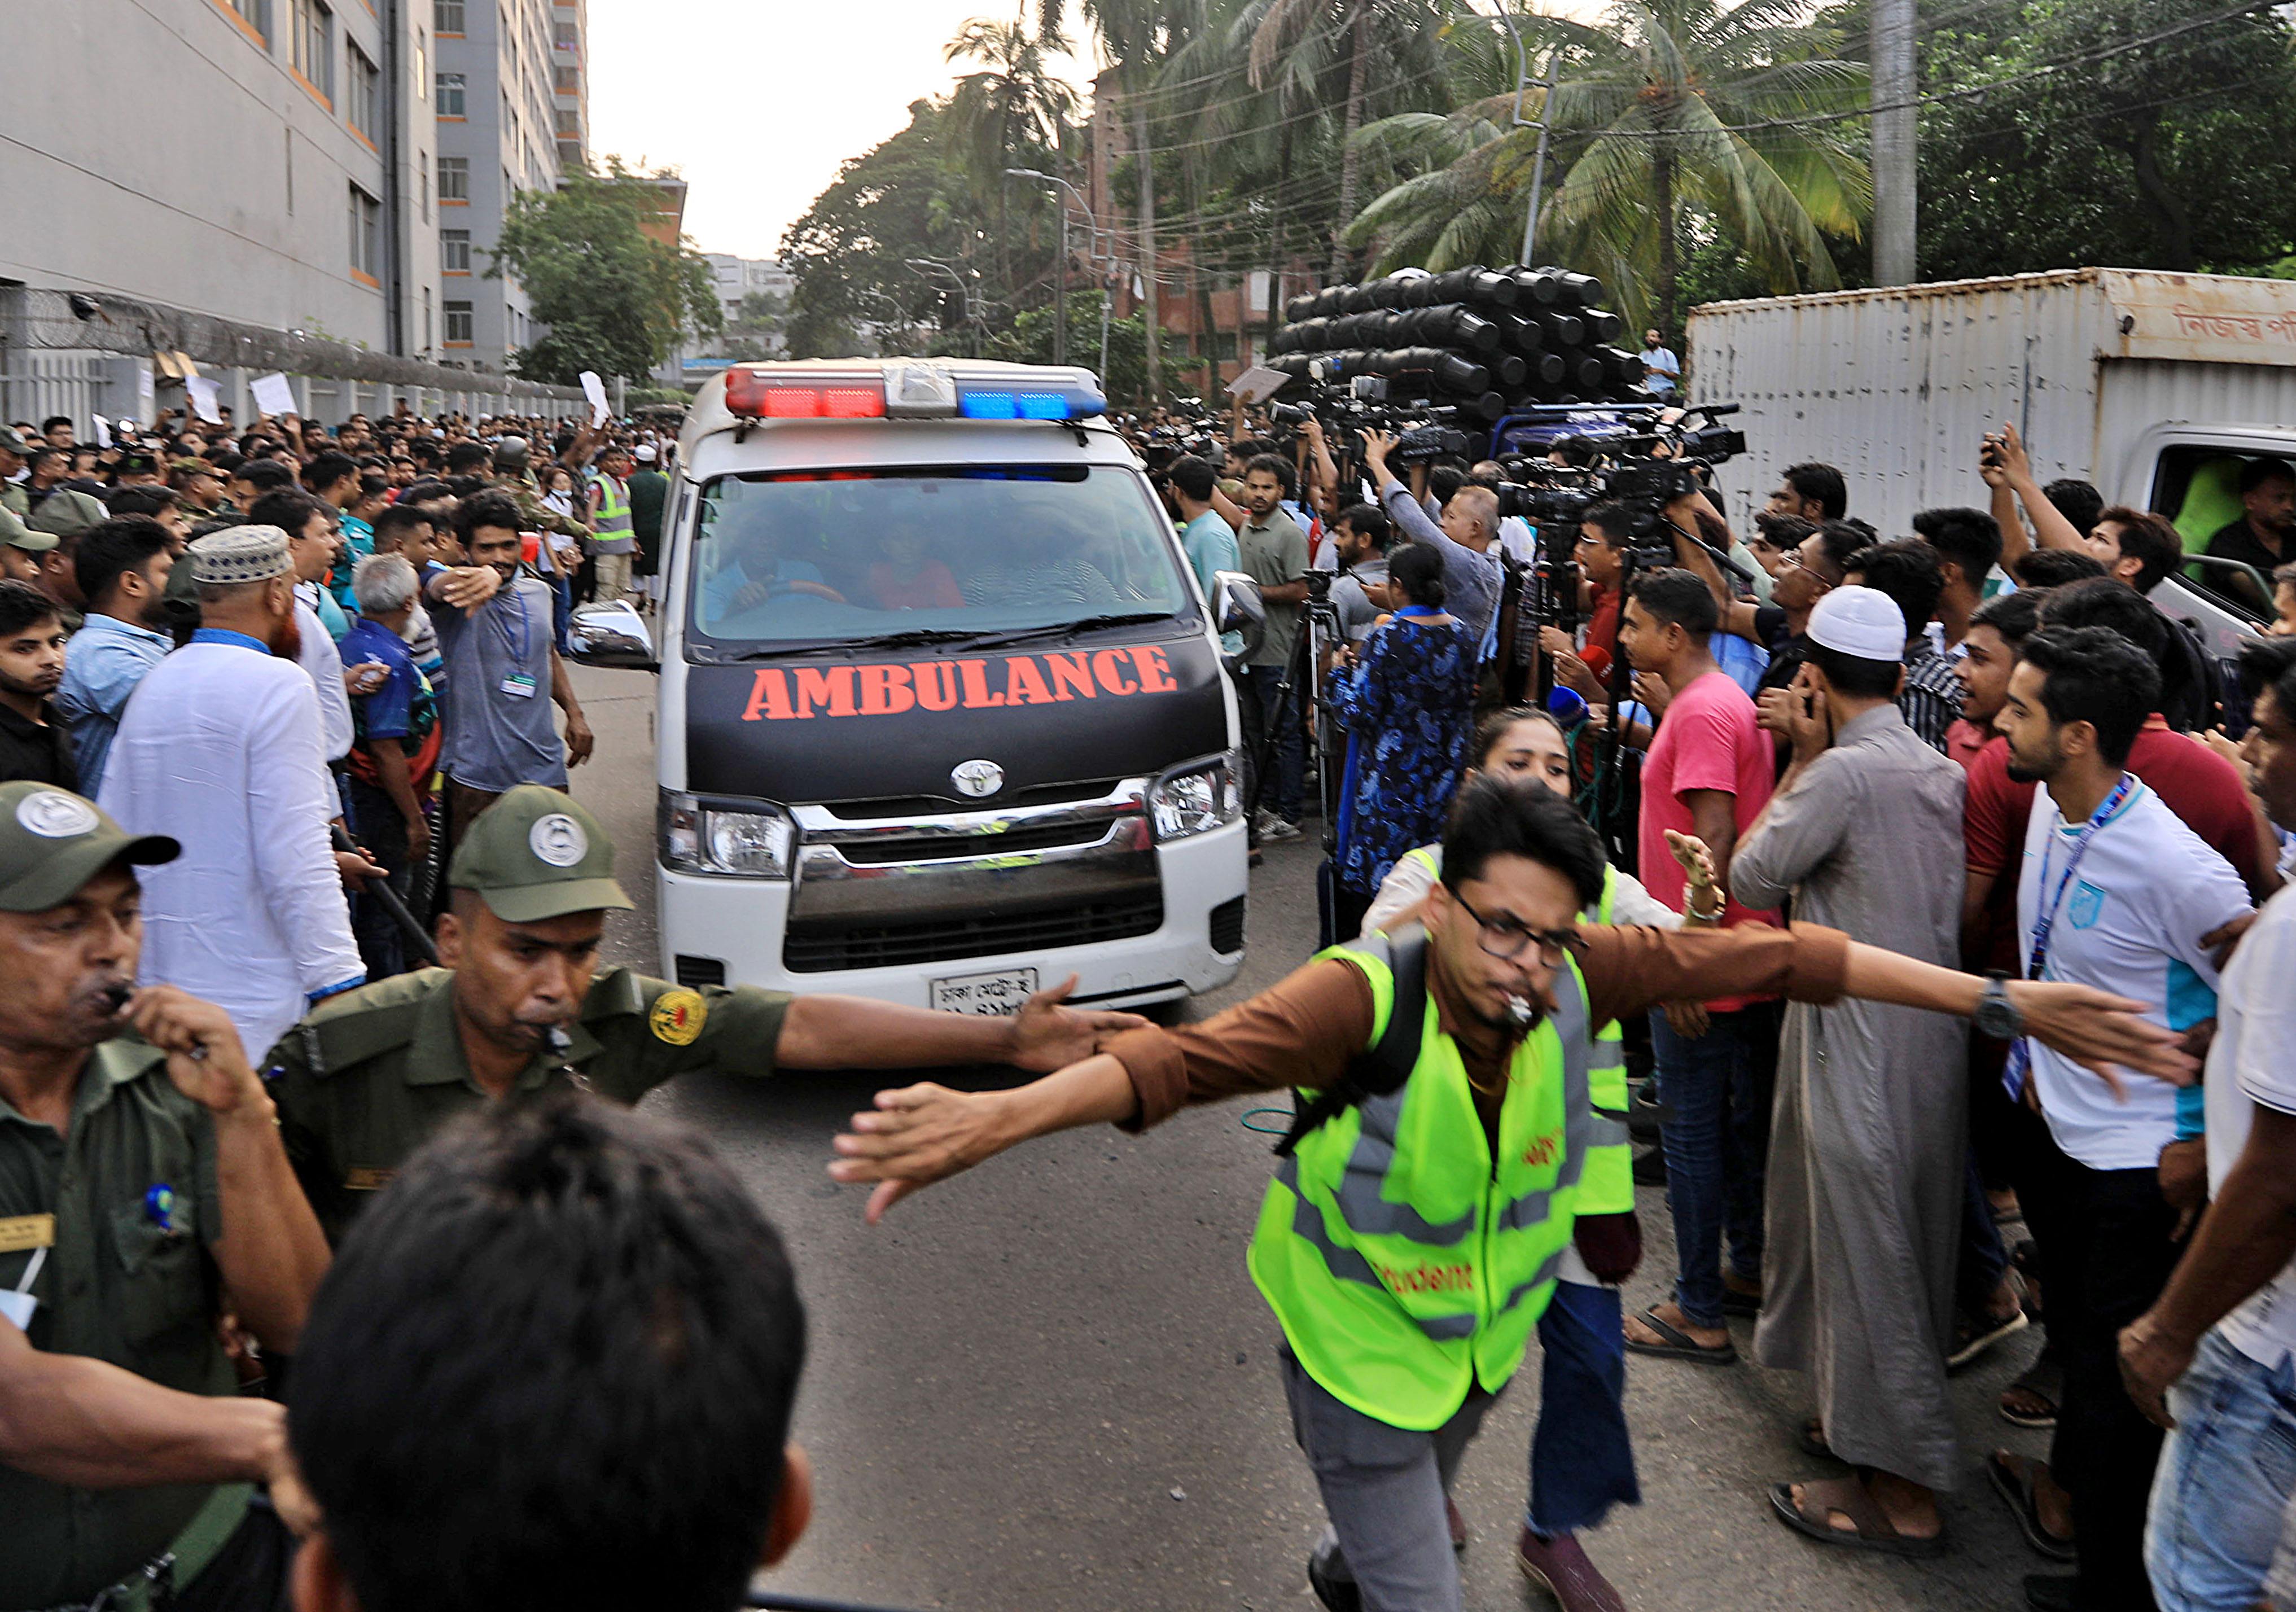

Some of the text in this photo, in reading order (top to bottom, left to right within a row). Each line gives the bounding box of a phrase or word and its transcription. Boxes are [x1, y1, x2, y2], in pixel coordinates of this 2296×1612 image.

[2172, 303, 2264, 342] নিজস্ব
[741, 645, 1177, 721] AMBULANCE
[939, 985, 971, 1002] ঢাকা
